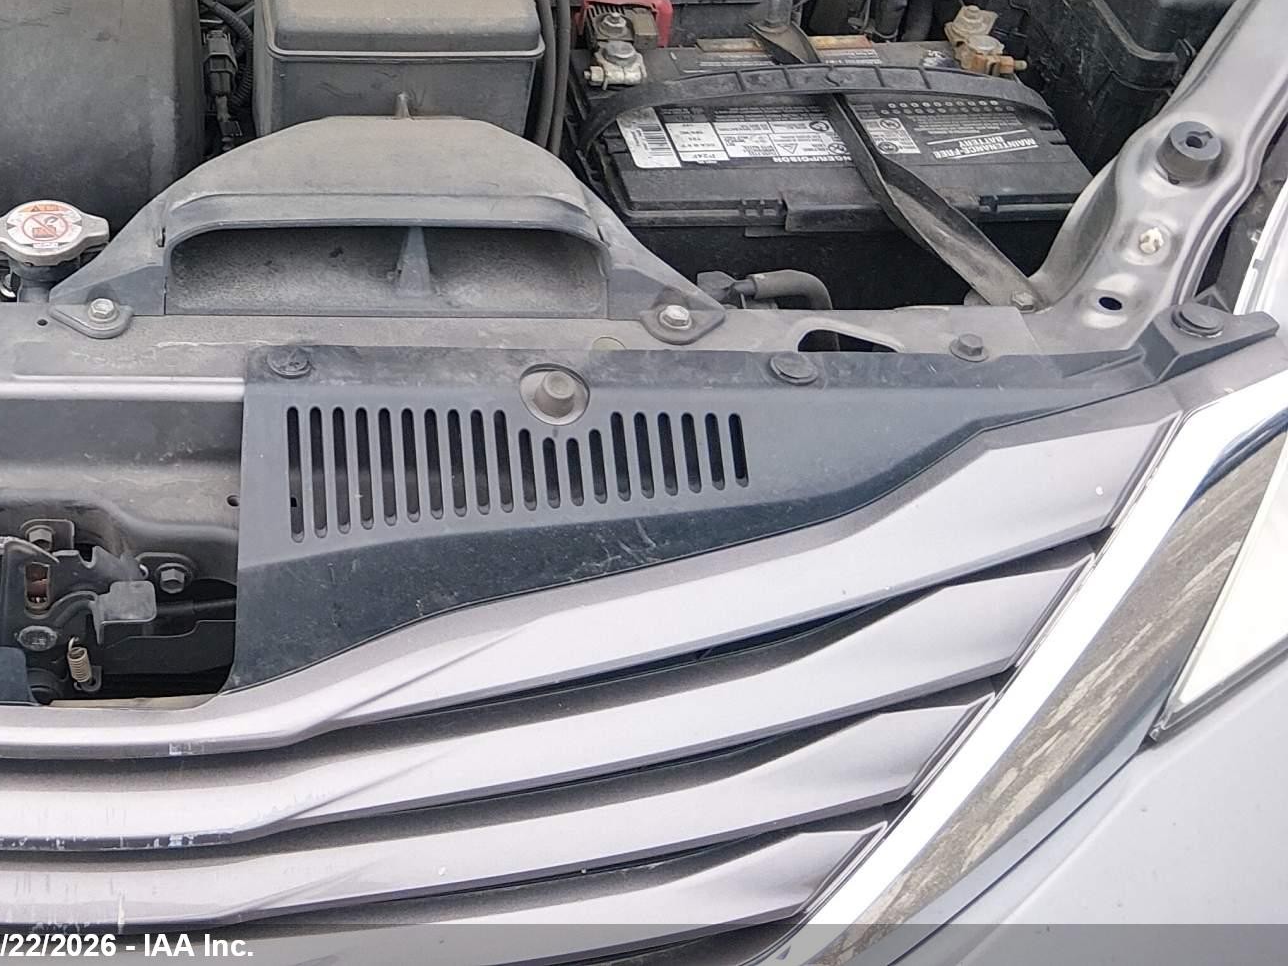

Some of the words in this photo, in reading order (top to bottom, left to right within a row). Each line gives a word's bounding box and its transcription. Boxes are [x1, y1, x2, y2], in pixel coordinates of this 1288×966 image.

[958, 135, 1004, 148] BATTERY
[933, 137, 1036, 160] MAINTENANCE-FREE
[772, 155, 853, 163] NGER/POISON
